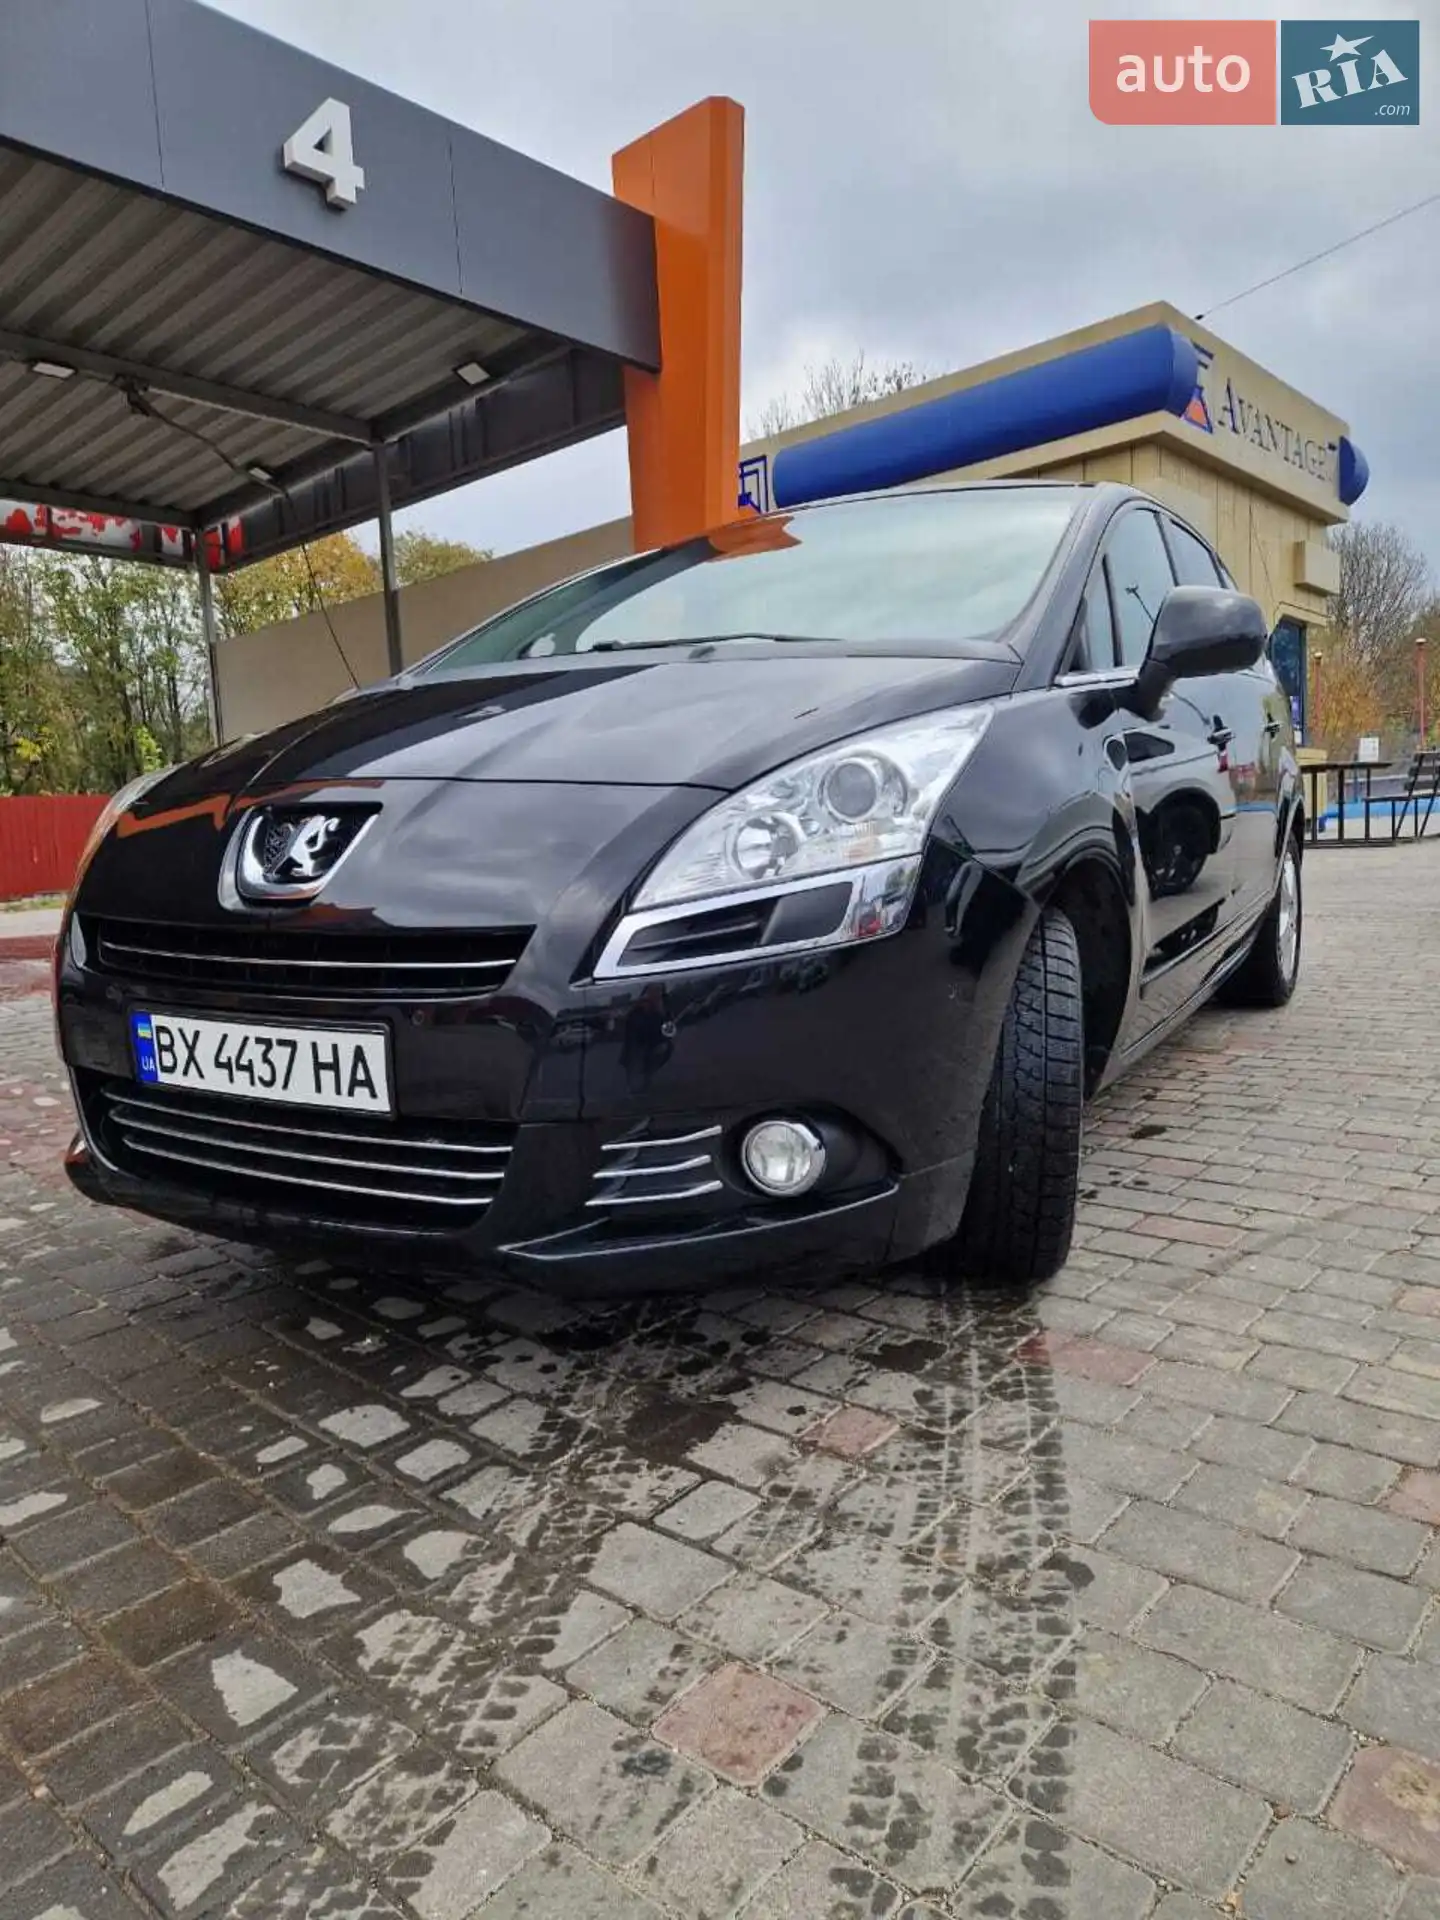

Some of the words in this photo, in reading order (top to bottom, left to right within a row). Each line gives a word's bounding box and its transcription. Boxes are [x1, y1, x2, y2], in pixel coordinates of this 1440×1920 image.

[283, 97, 365, 207] 4
[142, 1057, 155, 1072] UA
[155, 1025, 204, 1079] BX
[214, 1033, 298, 1090] 4437
[311, 1042, 378, 1099] HA
